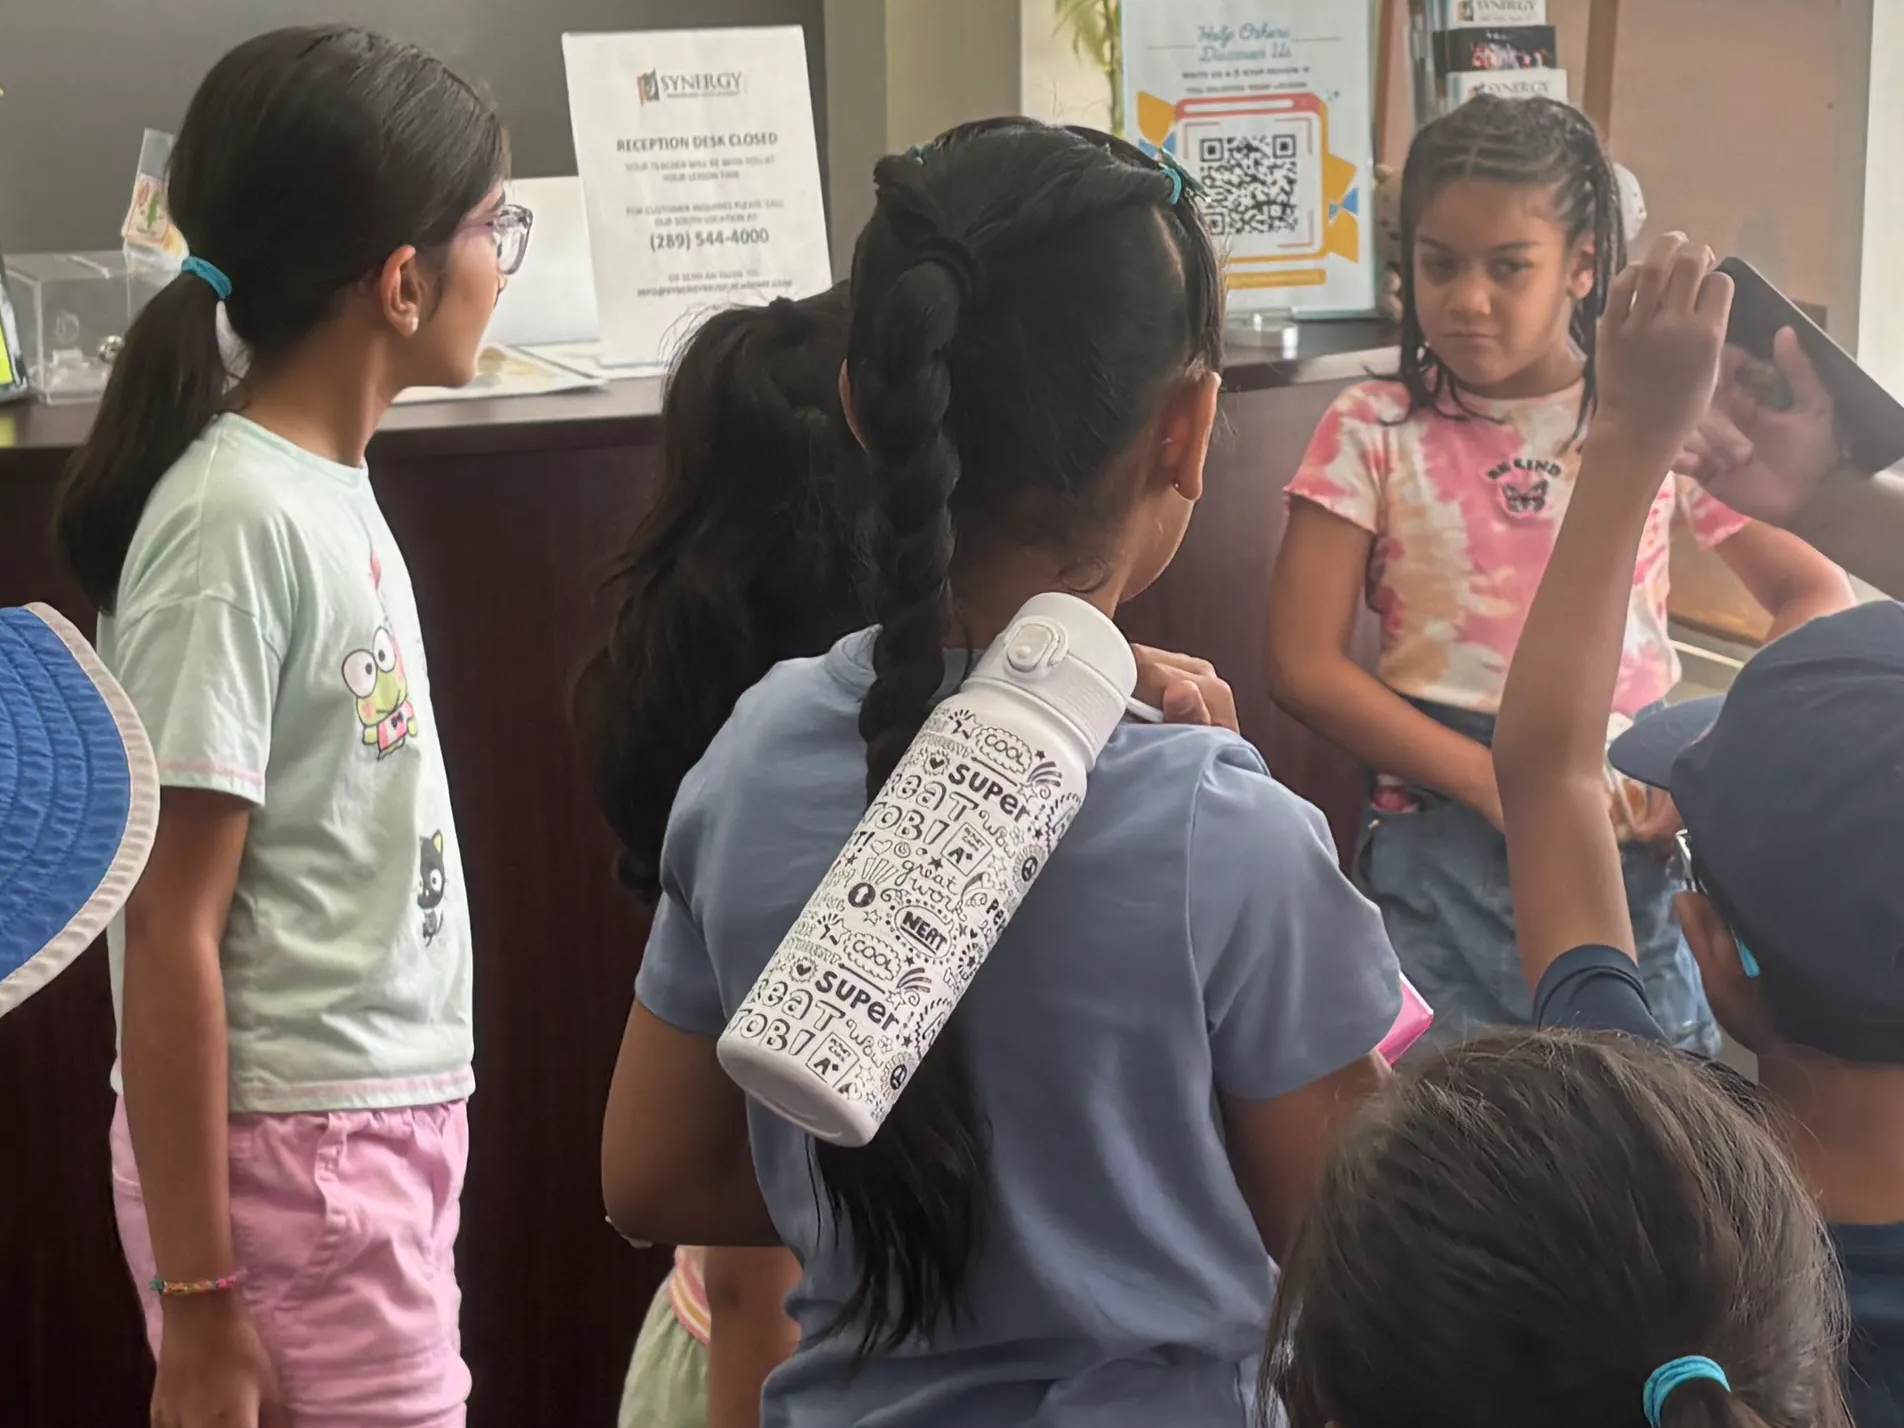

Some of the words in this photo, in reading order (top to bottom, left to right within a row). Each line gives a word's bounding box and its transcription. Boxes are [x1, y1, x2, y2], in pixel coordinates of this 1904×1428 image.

[660, 71, 743, 92] SYNERGY
[617, 136, 690, 153] RECEPTION
[693, 134, 726, 149] DESK
[729, 132, 779, 148] CLOSED
[649, 232, 691, 253] (289)
[695, 228, 771, 248] 544-4000
[1513, 458, 1562, 479] KIND
[984, 732, 1027, 772] COOL
[902, 910, 948, 952] NEAT
[852, 939, 895, 980] COOL
